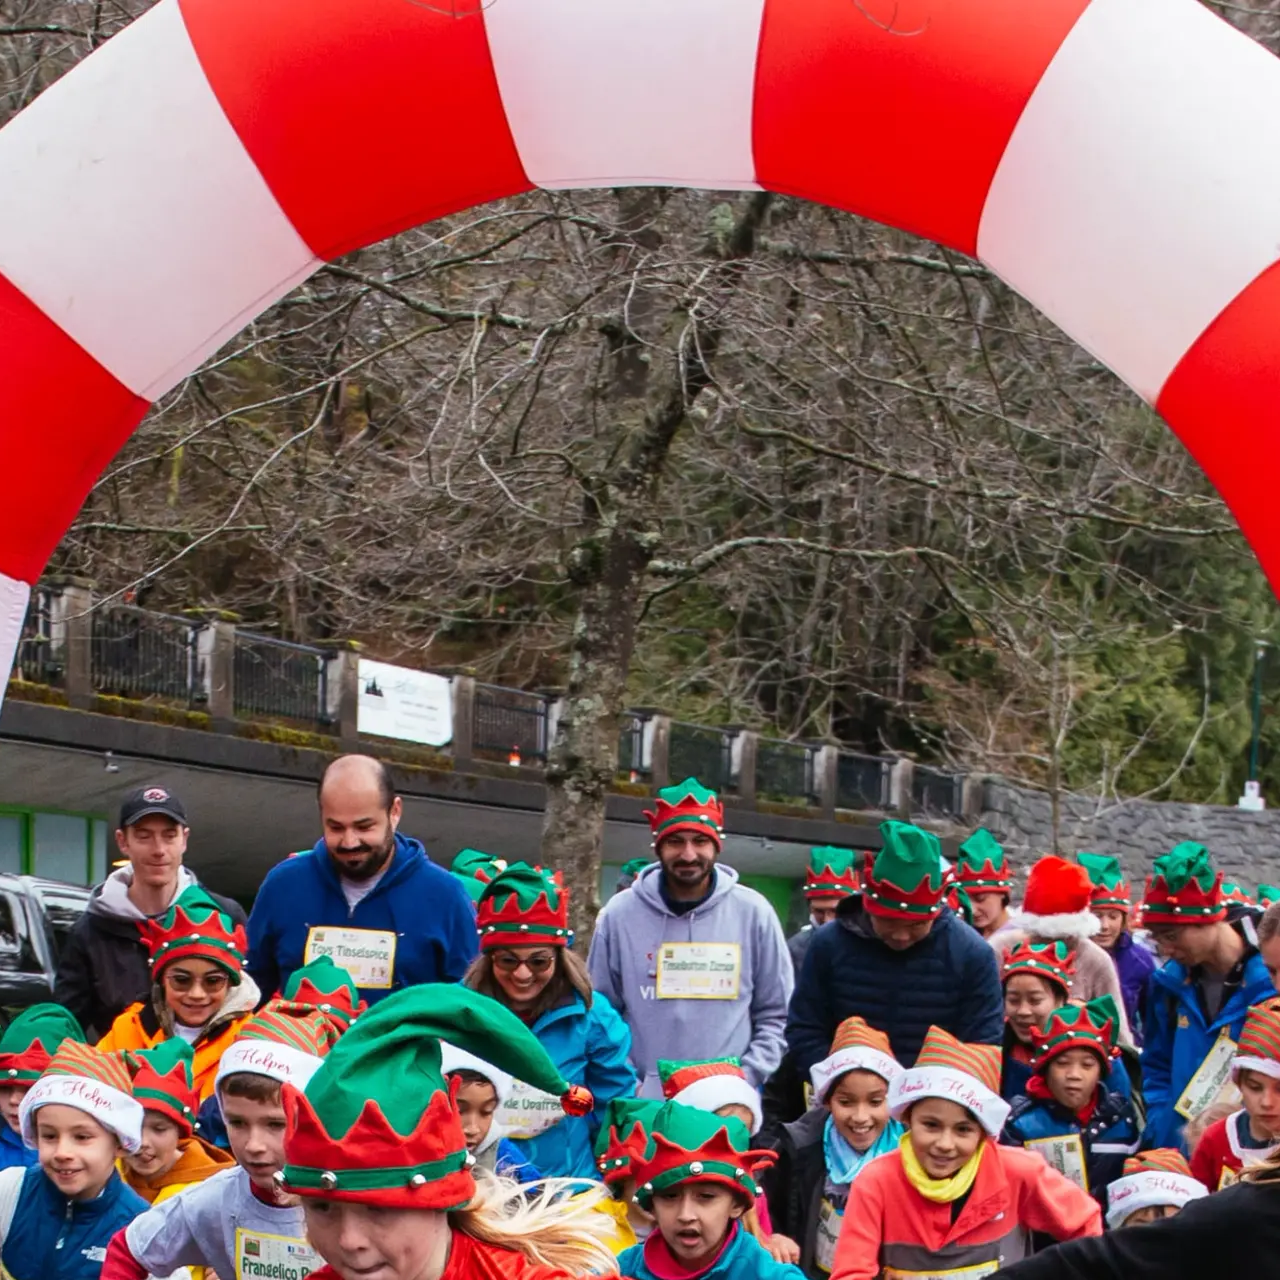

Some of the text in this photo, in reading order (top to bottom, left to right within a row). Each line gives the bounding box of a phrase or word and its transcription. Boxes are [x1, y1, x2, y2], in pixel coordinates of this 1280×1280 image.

[639, 985, 655, 1000] VI
[234, 1047, 292, 1074] Helper
[62, 1080, 114, 1111] Helper
